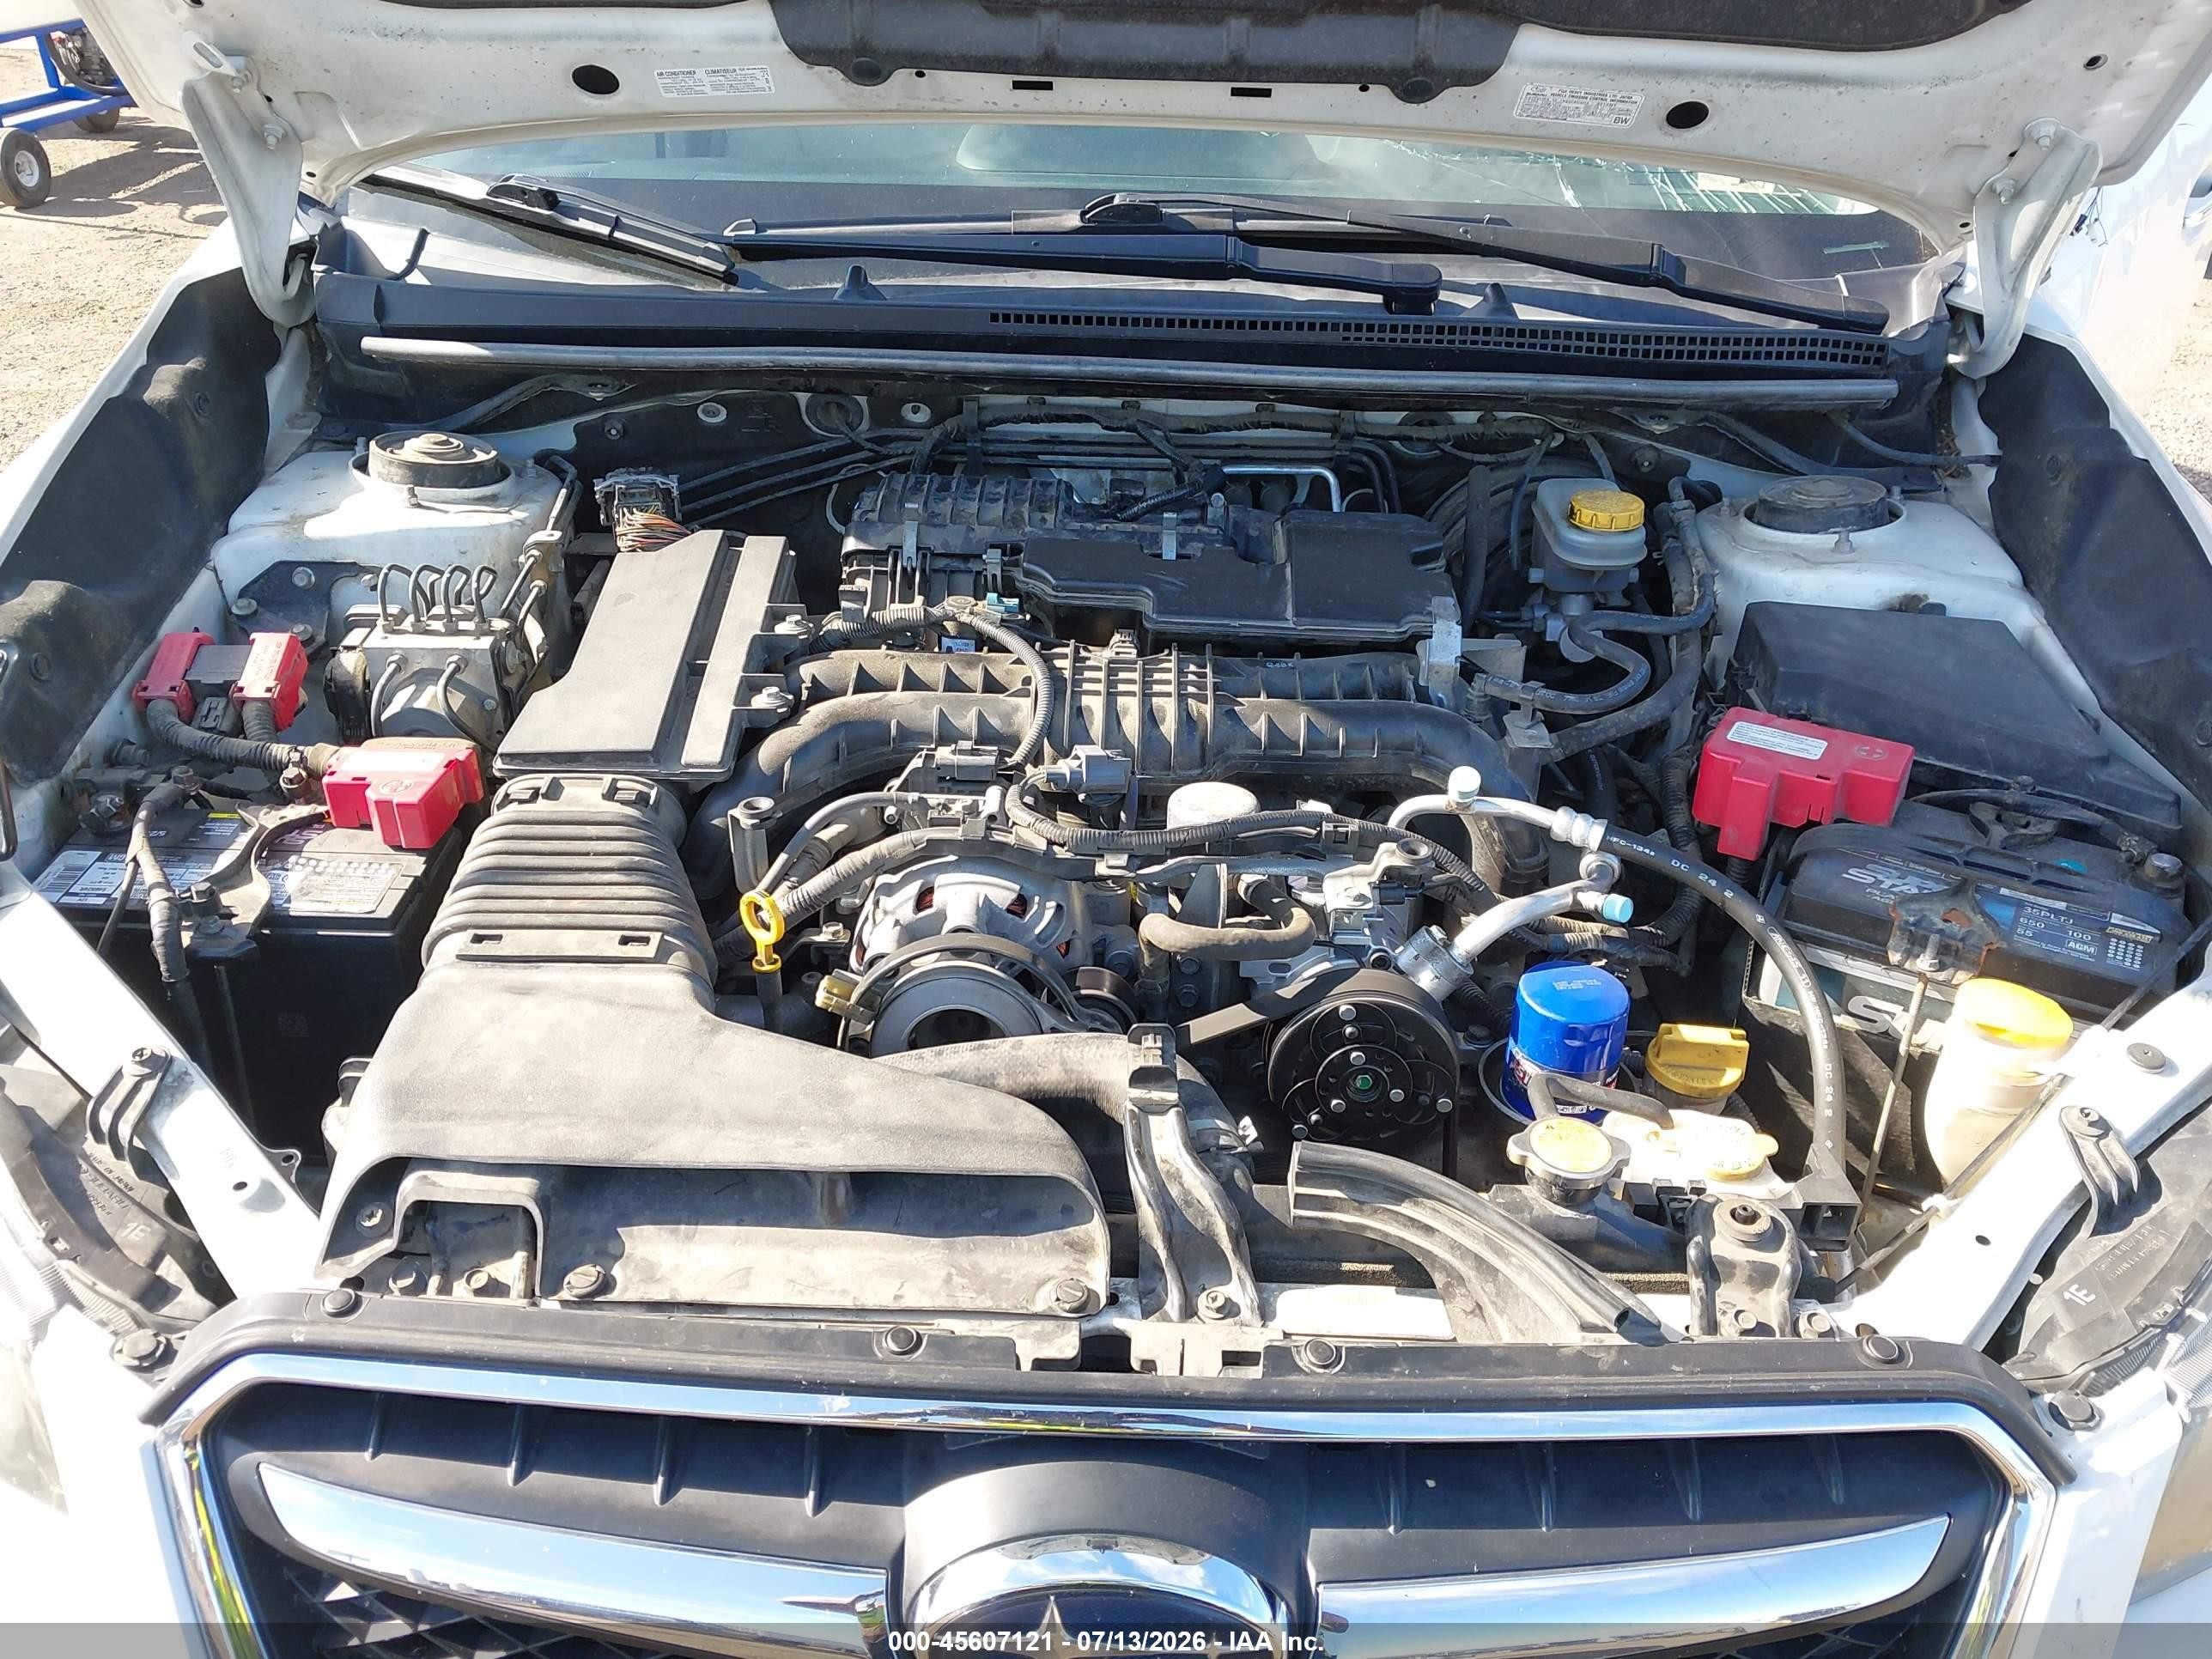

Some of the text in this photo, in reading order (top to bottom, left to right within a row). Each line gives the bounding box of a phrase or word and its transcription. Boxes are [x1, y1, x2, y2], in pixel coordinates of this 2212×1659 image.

[1613, 116, 1631, 125] BW
[1670, 859, 1690, 872] DC
[1698, 872, 1717, 888] 24
[2015, 927, 2034, 937] 55
[2019, 917, 2092, 940] 650 100
